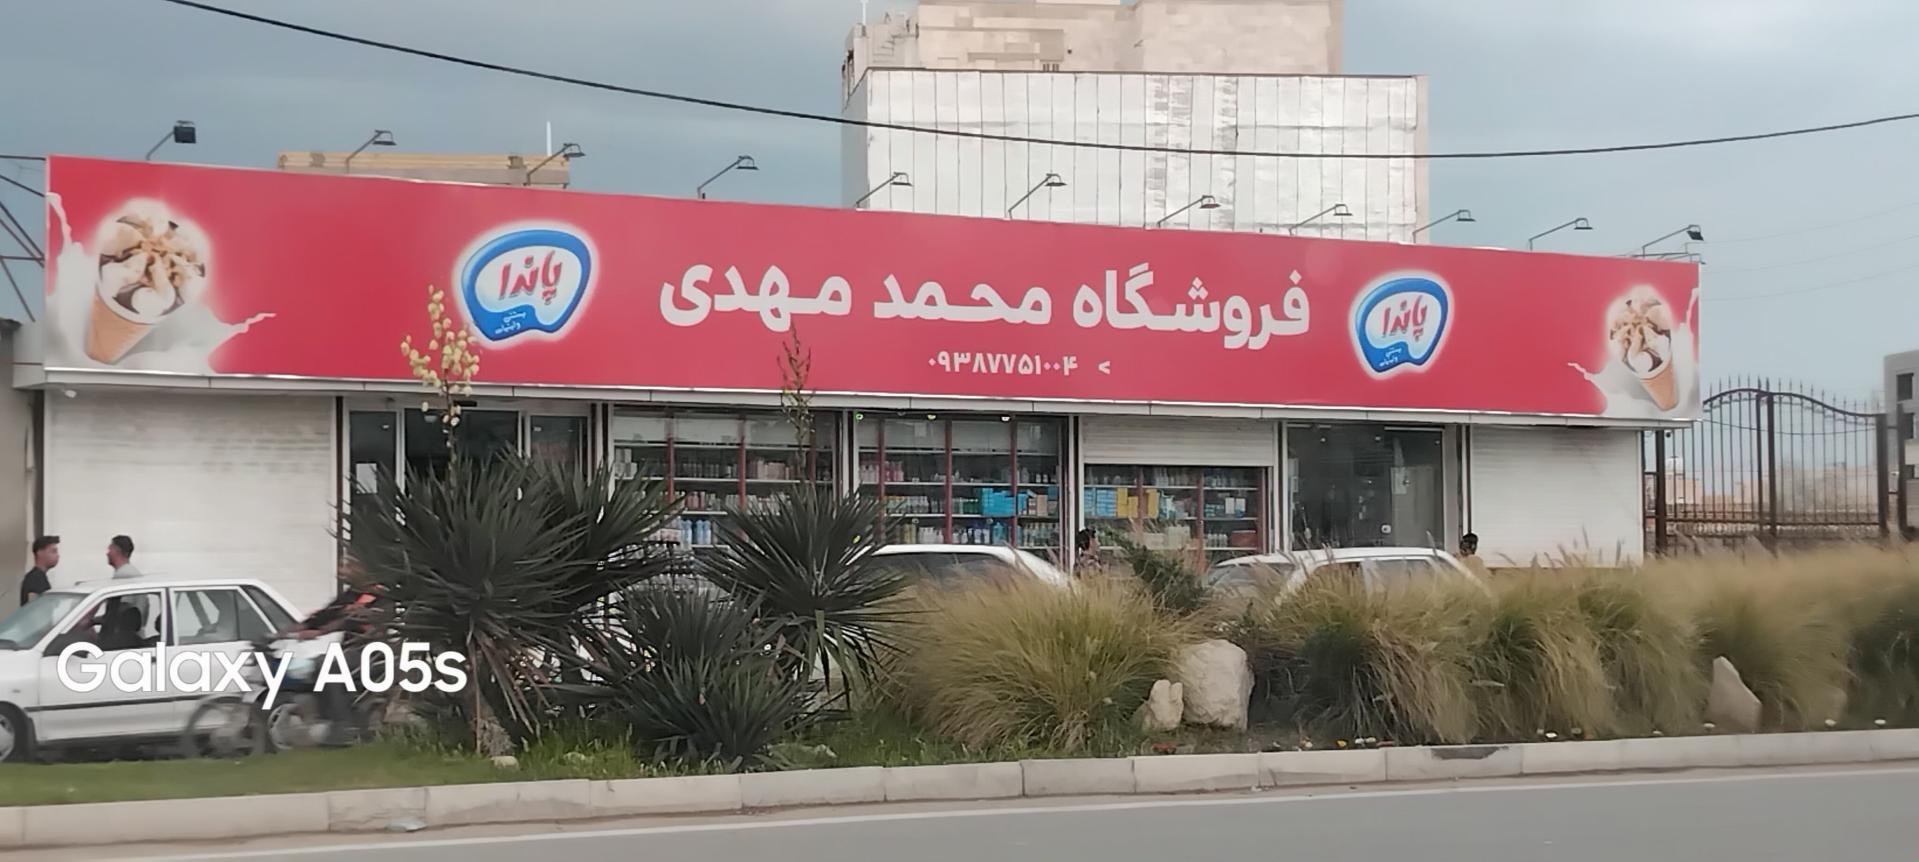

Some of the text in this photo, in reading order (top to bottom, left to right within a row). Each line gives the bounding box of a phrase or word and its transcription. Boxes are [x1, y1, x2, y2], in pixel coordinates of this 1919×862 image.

[499, 249, 562, 305] پاندا
[659, 262, 1310, 350] فروشگاه محمد مهدی
[1381, 294, 1428, 342] پاندا
